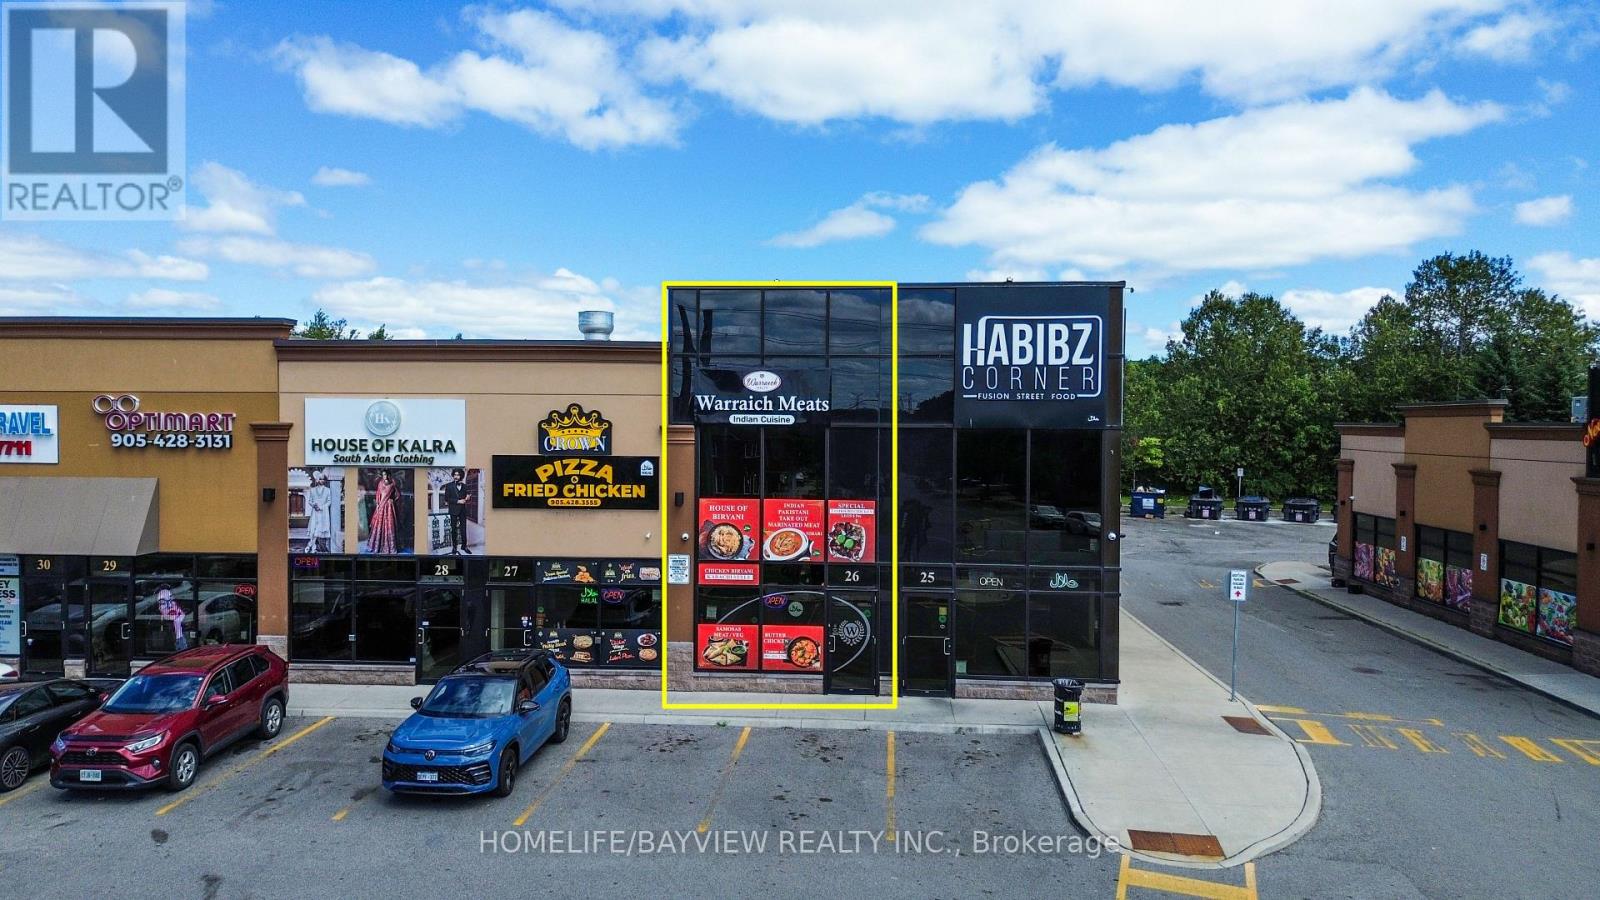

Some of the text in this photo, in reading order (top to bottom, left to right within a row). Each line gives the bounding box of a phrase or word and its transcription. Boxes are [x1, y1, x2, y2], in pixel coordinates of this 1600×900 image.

[962, 322, 1094, 366] HABIBZ
[962, 366, 1094, 390] CORNER
[695, 394, 830, 412] Warraich Meats
[105, 410, 236, 432] OPTIMART
[733, 415, 791, 424] Indian Cuisine
[110, 433, 231, 448] 905-428-3131
[310, 438, 457, 454] HOUSE OF KALRA
[543, 435, 607, 452] CROWN
[333, 453, 435, 465] South Asian Clothing
[534, 458, 614, 485] PIZZA
[503, 483, 646, 498] FRIED CHICKEN
[709, 504, 749, 512] HOUSE OF
[37, 559, 51, 570] 30
[103, 560, 117, 571] 29
[294, 556, 319, 567] OPEN
[434, 564, 449, 576] 28
[504, 565, 519, 577] 27
[844, 570, 860, 582] 26
[920, 571, 935, 583] 25
[979, 576, 1004, 586] OPEN
[236, 586, 255, 595] OPEN
[603, 589, 625, 600] OPEN
[767, 596, 785, 605] OPEN
[845, 626, 858, 636] W
